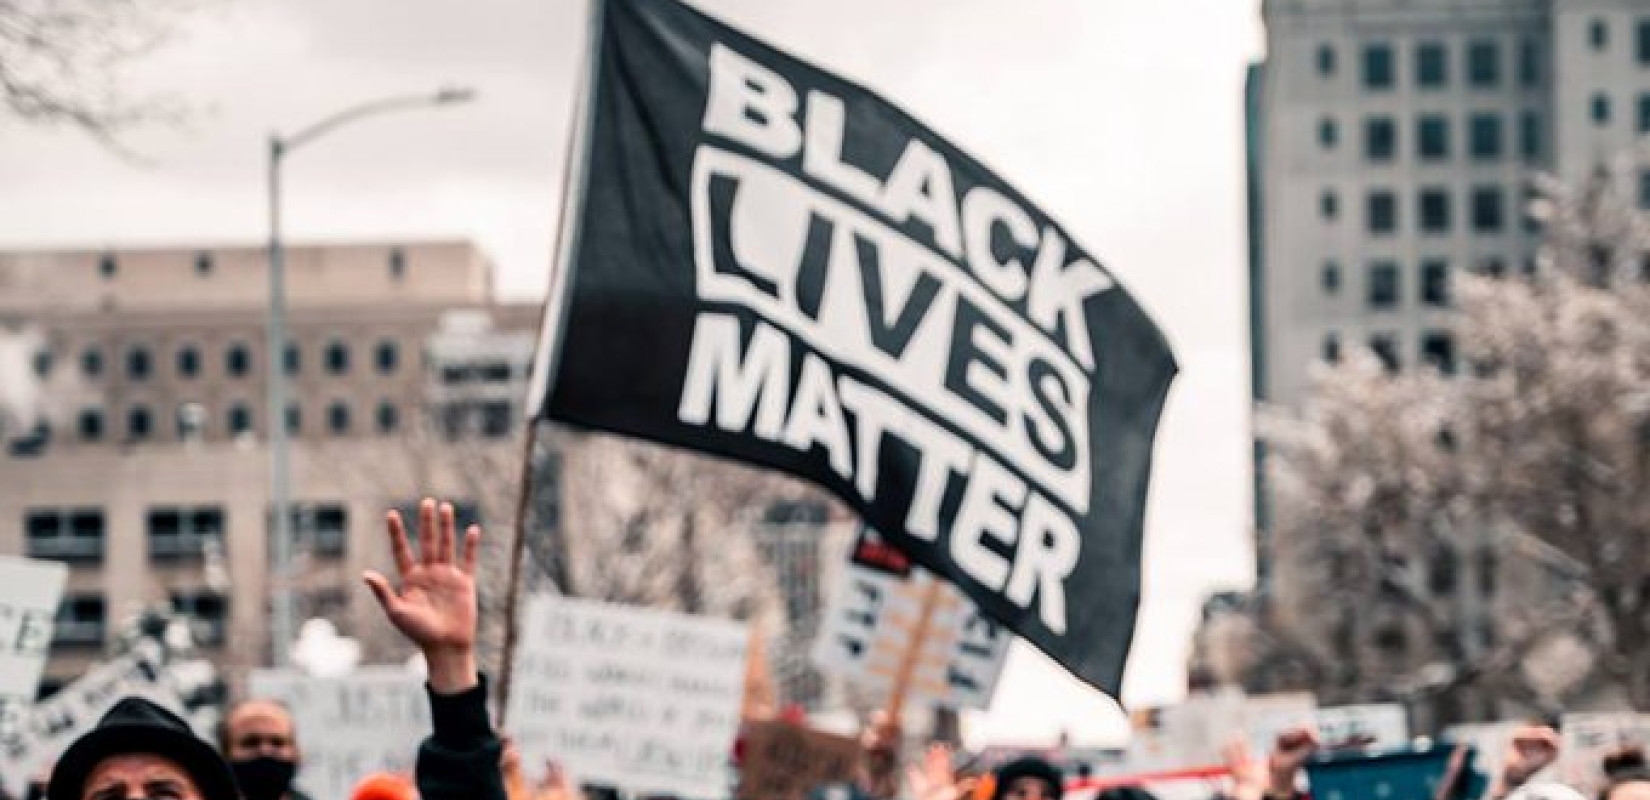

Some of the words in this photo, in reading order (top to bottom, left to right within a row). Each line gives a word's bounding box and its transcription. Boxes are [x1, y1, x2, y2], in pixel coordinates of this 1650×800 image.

[702, 41, 1115, 373] BLACK
[706, 170, 1078, 472] LIVES
[678, 311, 1081, 635] MATTER
